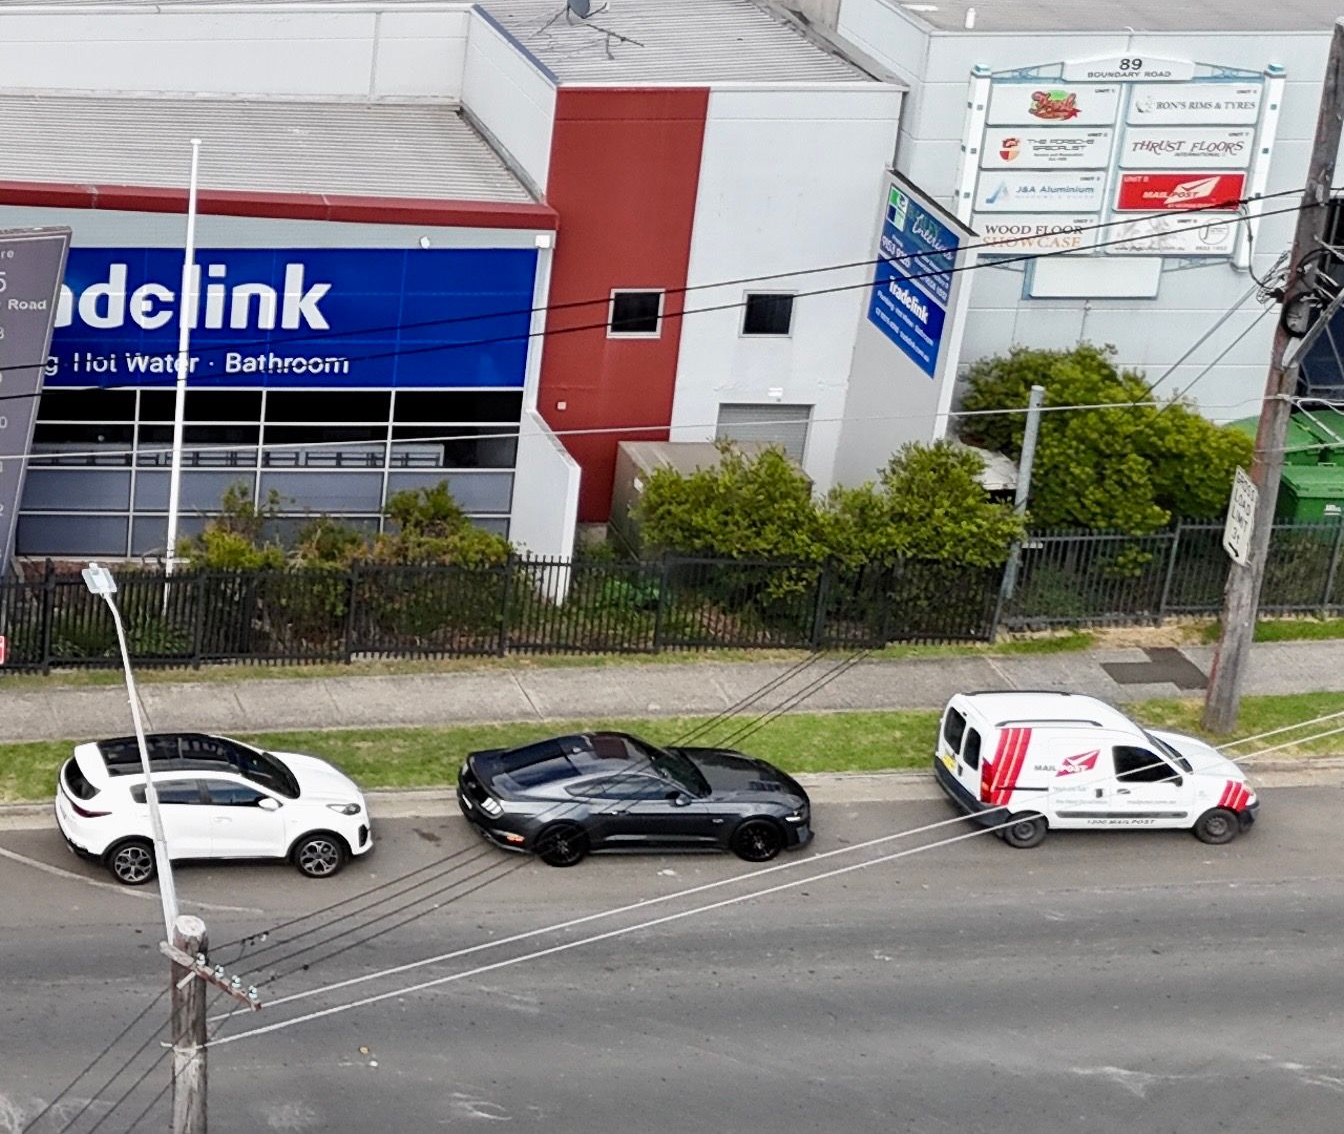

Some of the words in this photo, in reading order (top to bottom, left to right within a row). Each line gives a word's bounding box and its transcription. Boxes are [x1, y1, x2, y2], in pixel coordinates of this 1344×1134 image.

[1119, 58, 1142, 70] 89
[1132, 140, 1186, 155] THRUST
[1190, 141, 1245, 156] FLOORS
[1142, 191, 1169, 199] MAIL
[985, 225, 1031, 234] WOOD
[1035, 225, 1083, 235] FLOOR
[982, 236, 1081, 248] SHOWCASE
[8, 299, 47, 310] Road
[889, 275, 929, 325] Tradelink
[74, 353, 117, 372] Hot
[126, 352, 199, 373] Water
[225, 352, 349, 374] Bathroom
[1235, 487, 1251, 516] LOAD
